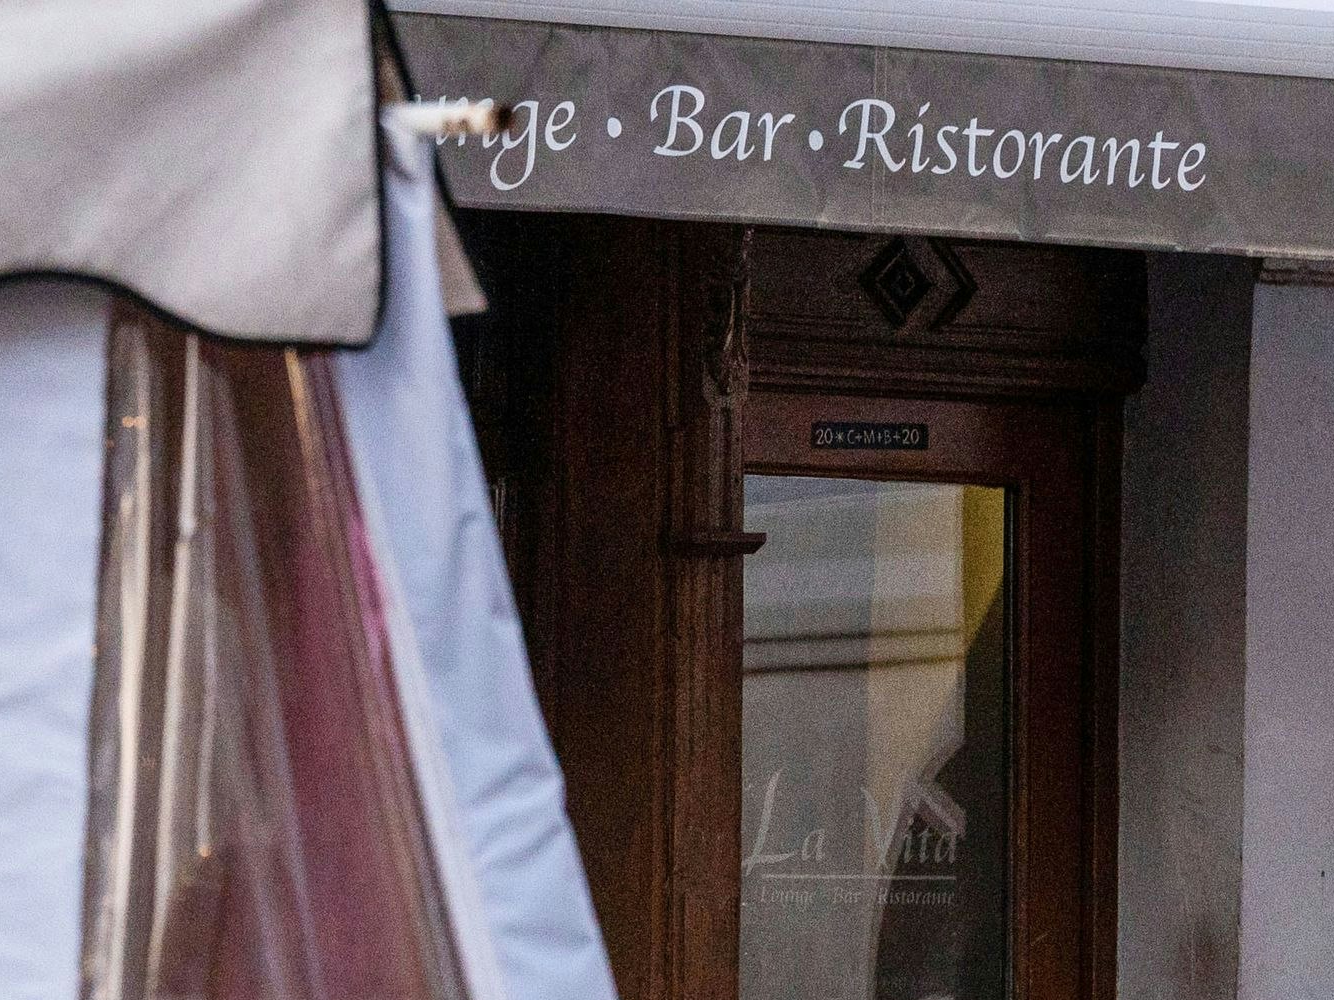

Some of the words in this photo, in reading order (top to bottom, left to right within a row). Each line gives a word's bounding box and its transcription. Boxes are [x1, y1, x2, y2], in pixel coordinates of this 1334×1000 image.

[650, 84, 796, 162] Bar
[838, 98, 1207, 192] Ristorante
[741, 770, 825, 876] La
[860, 786, 959, 870] Vita
